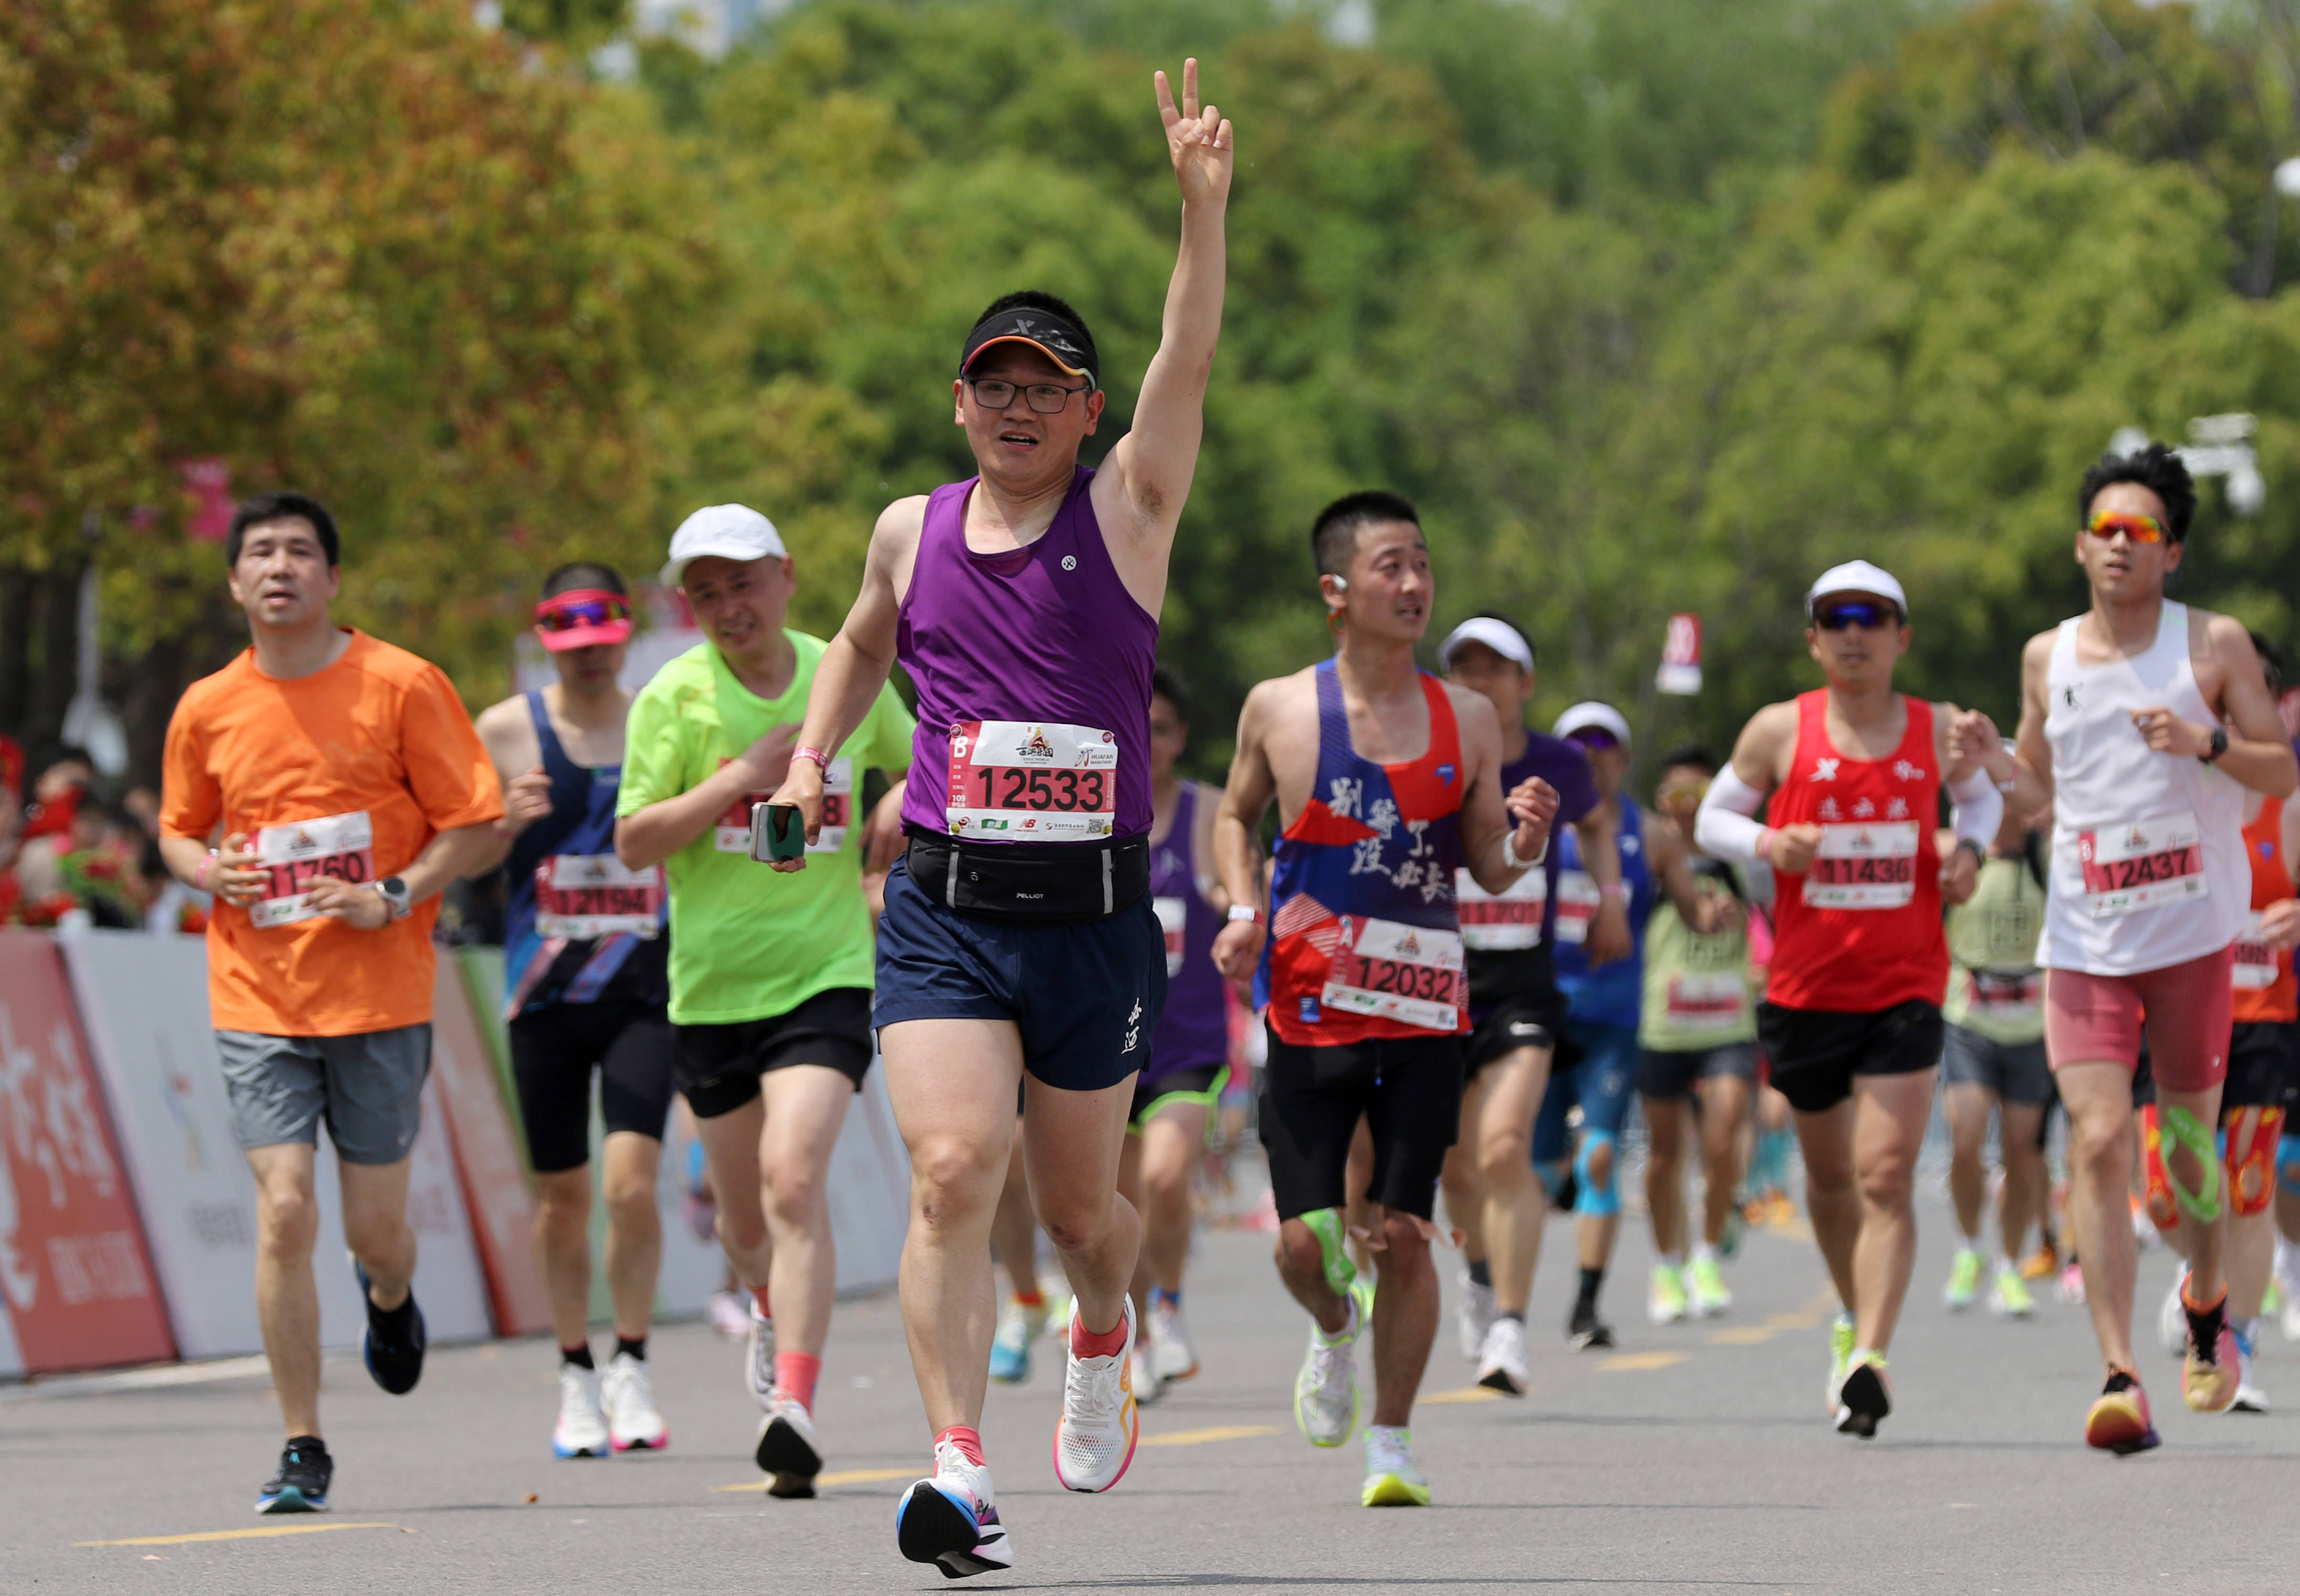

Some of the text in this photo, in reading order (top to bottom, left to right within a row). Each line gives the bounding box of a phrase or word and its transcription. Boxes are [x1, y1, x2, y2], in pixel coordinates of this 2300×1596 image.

[953, 736, 969, 758] B
[979, 767, 1103, 811] 12533
[267, 851, 365, 896] 11760
[1823, 858, 1911, 883] 11436
[2104, 848, 2189, 891] 12437
[1358, 958, 1453, 1002] 12032
